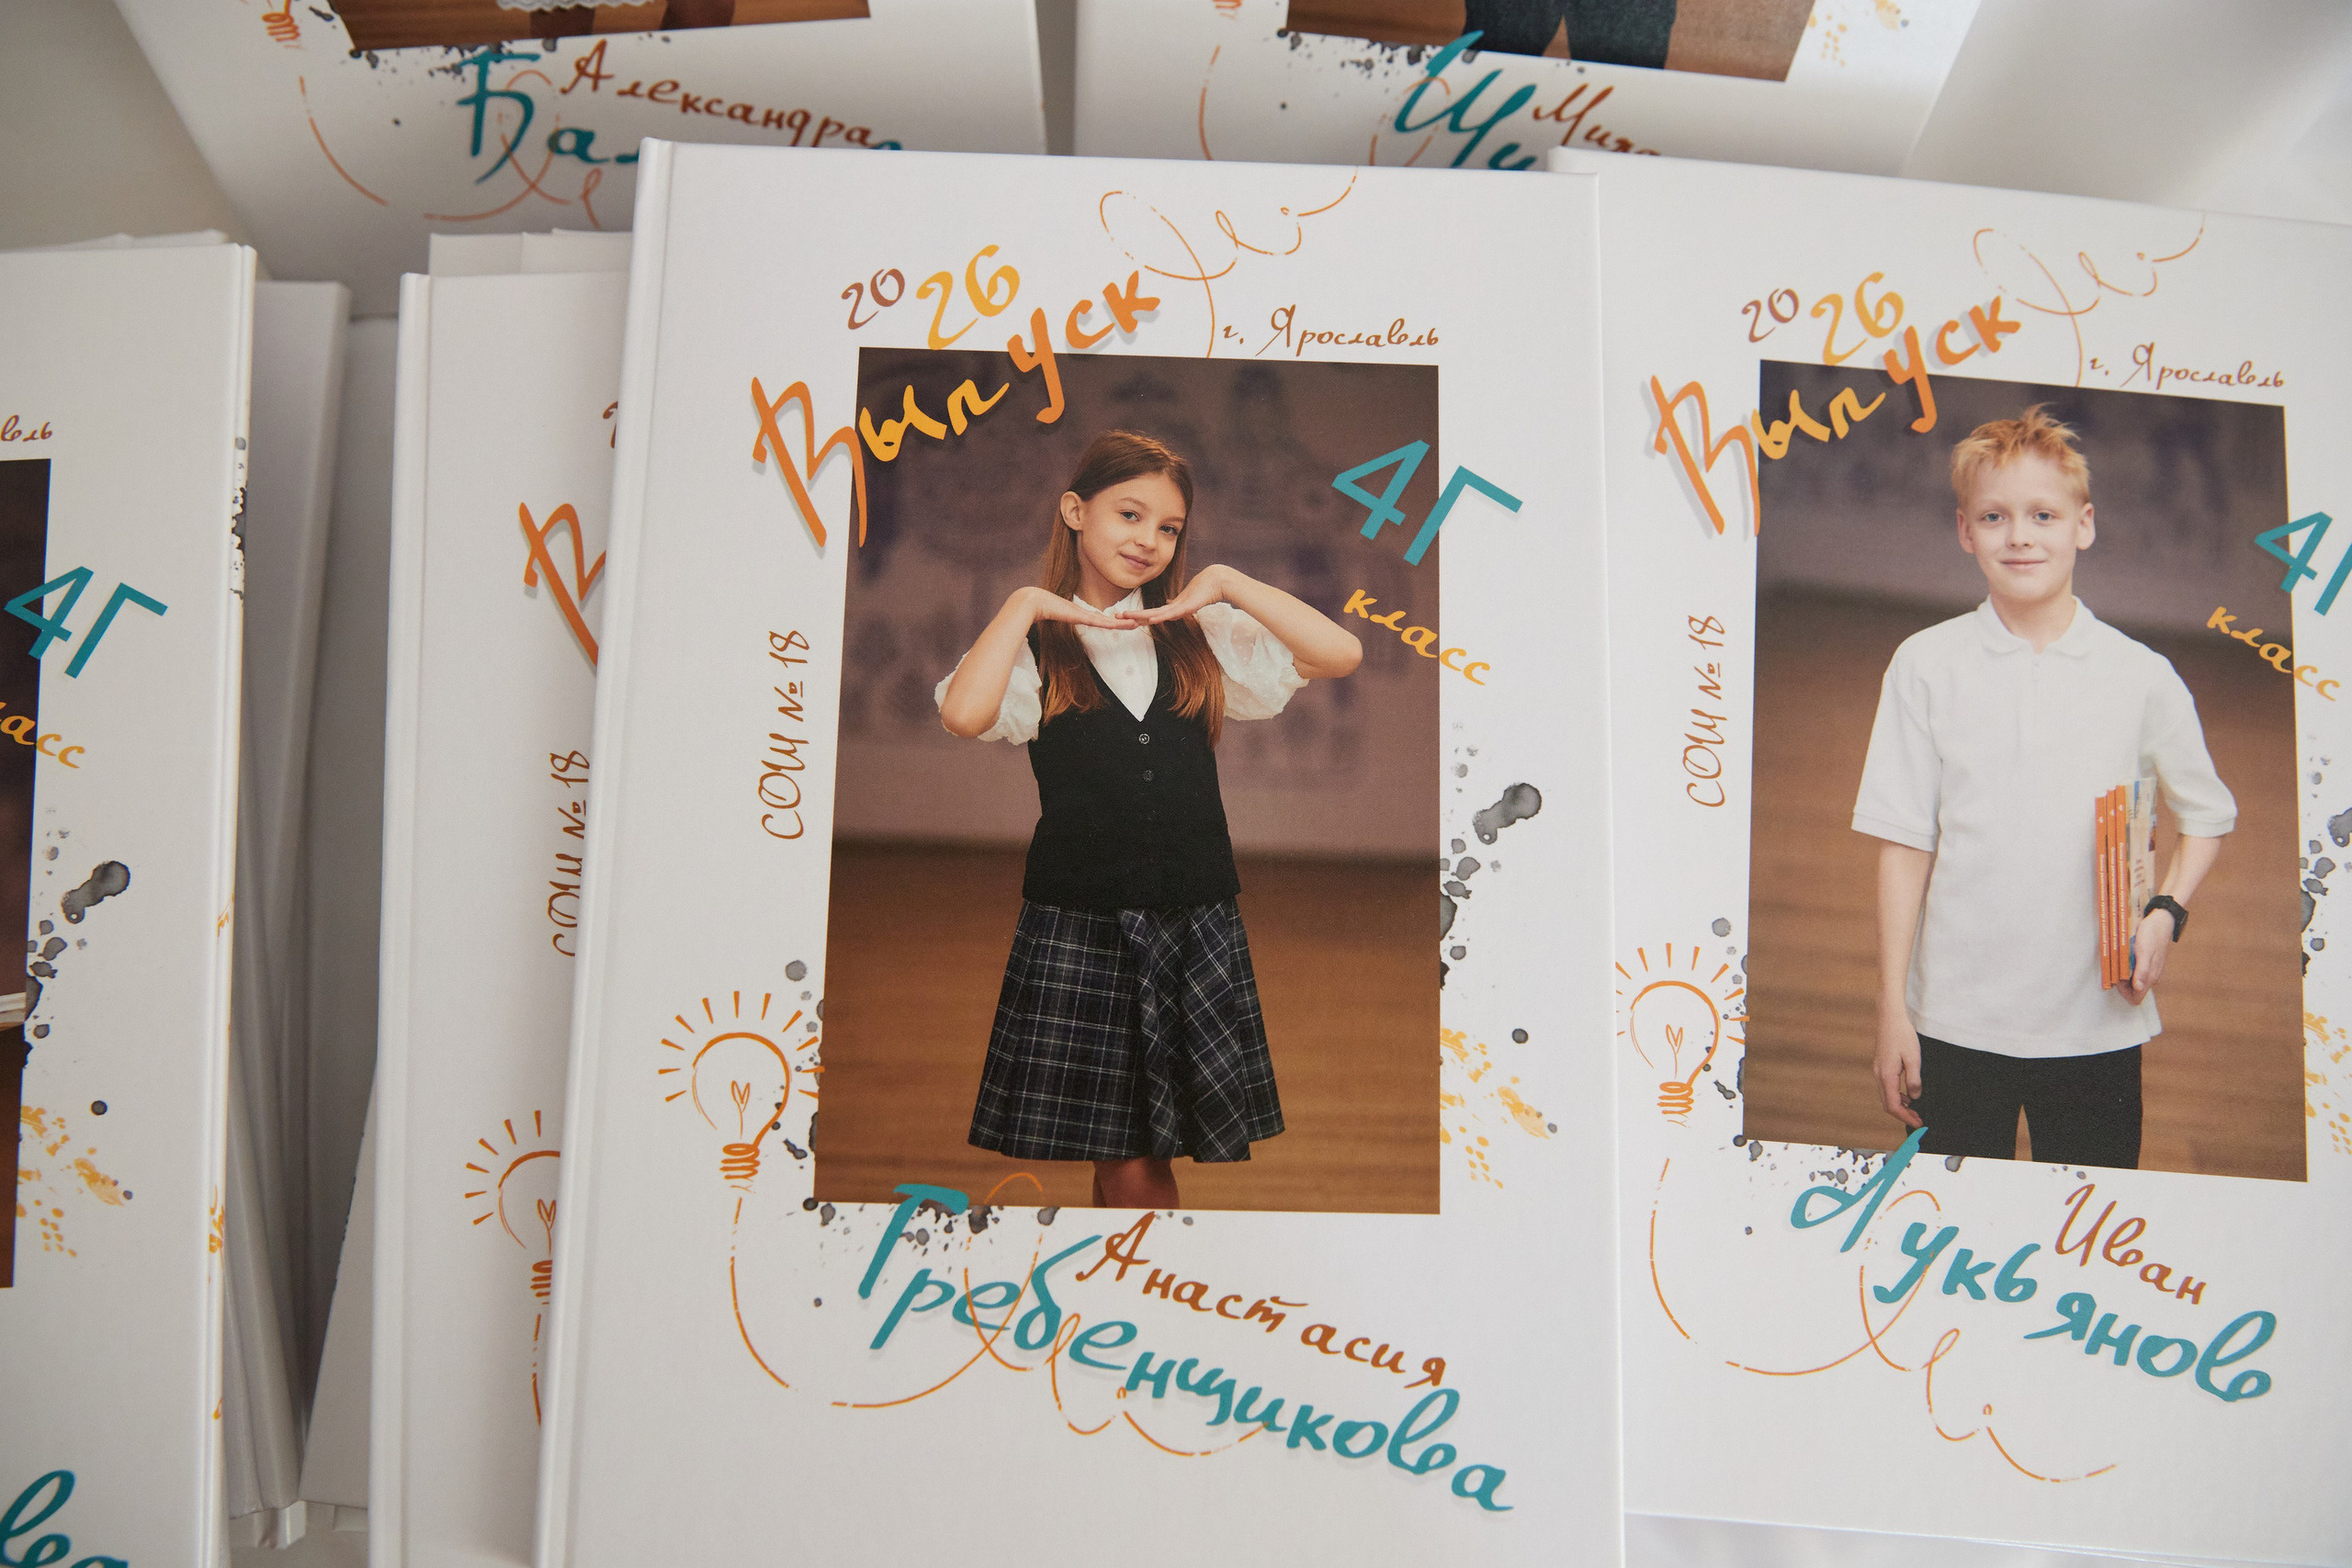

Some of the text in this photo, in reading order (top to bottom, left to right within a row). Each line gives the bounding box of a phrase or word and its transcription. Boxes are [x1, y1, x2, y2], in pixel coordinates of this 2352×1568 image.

[560, 39, 875, 148] Александра
[1223, 303, 1440, 357] г. Ярославль
[2120, 341, 2285, 390] Ярославль
[751, 270, 1161, 549] Выпуск
[1649, 294, 2021, 537] Выпуск
[1331, 438, 1524, 567] 4Г
[4, 566, 168, 679] 4Г
[768, 629, 810, 669] 18
[1342, 589, 1491, 687] класс
[1687, 615, 1725, 650] 18
[2206, 606, 2341, 702] класс
[0, 701, 86, 769] асс
[549, 750, 590, 789] 18
[758, 733, 809, 840] СОШ
[1682, 707, 1728, 807] СОШ
[1790, 1126, 2278, 1403] Лукьянов
[2054, 1183, 2208, 1305] Иван
[857, 1183, 1514, 1513] Гребенщикова
[1076, 1211, 1447, 1389] Анастасия
